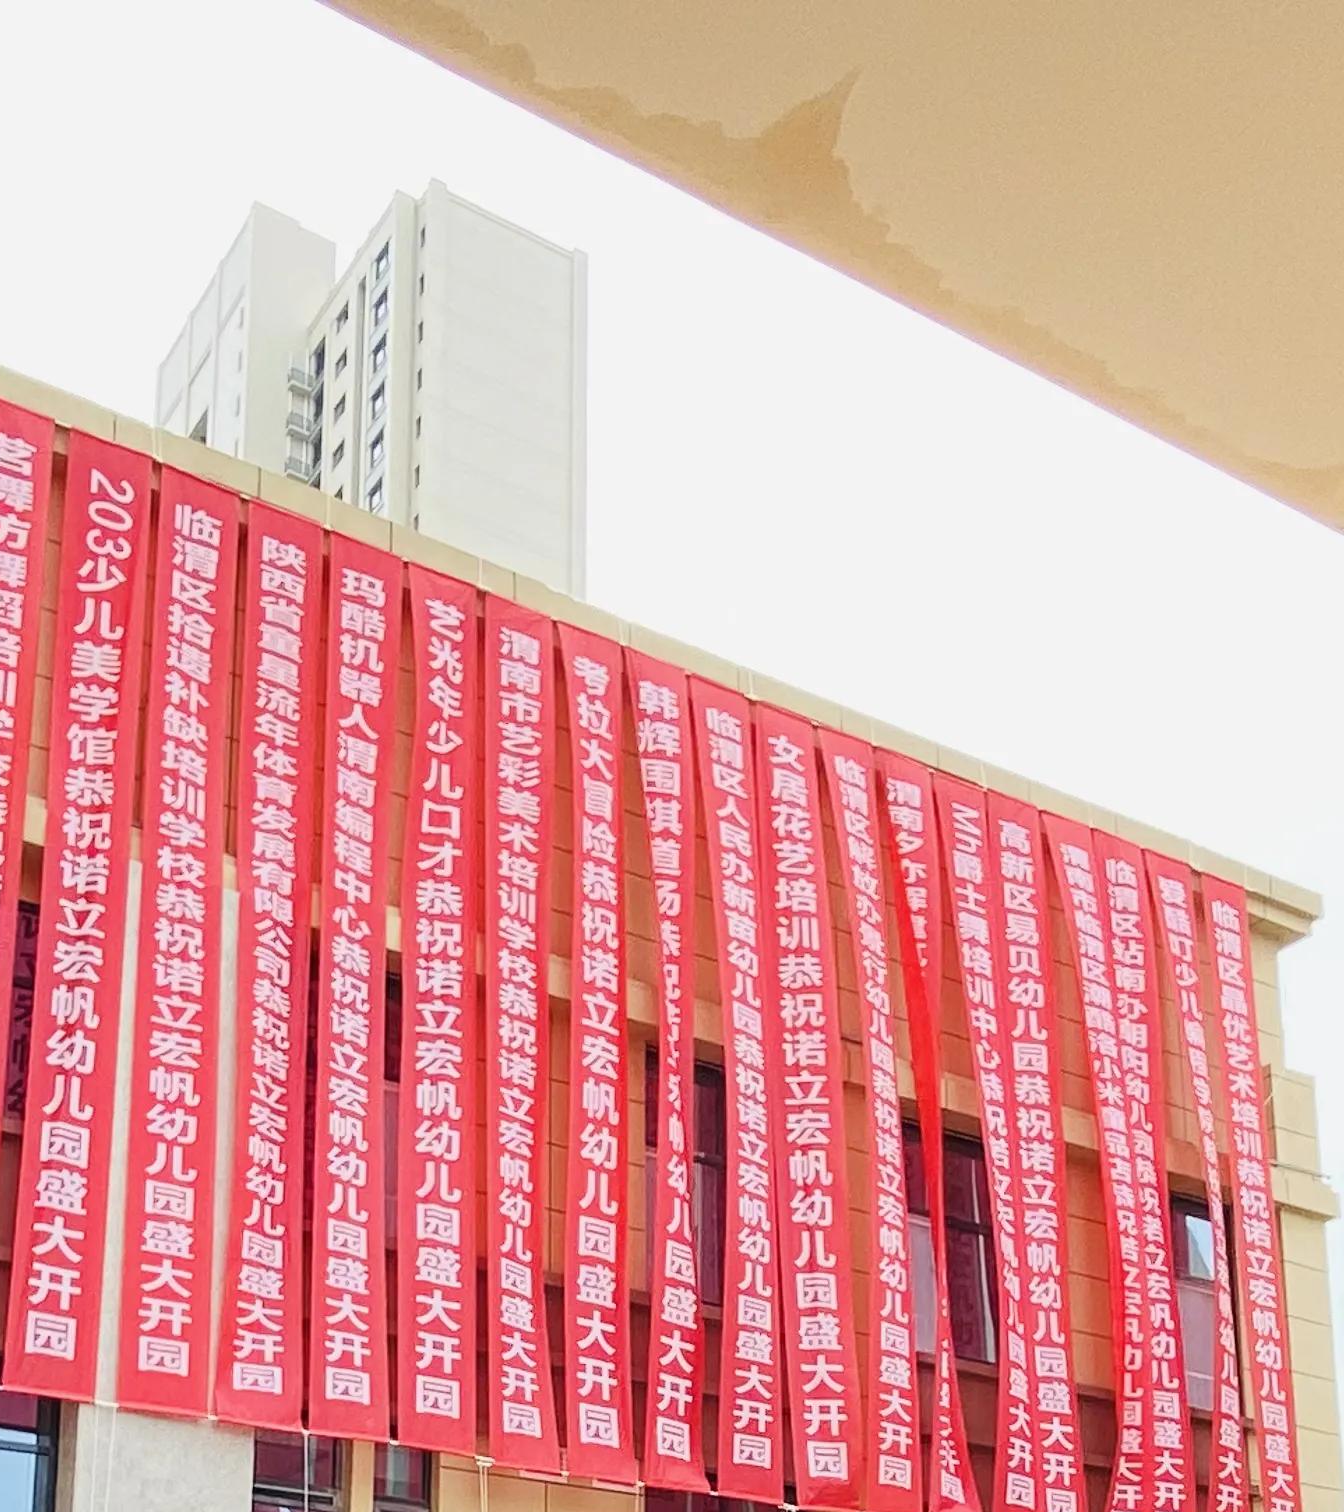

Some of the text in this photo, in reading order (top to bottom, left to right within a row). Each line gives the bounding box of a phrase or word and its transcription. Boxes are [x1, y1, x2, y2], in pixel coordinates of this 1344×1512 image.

[24, 468, 135, 1362] 203少儿美学馆恭祝诺立宏帆幼儿园盛大开园
[572, 654, 621, 1450] 考拉大冒险恭祝诺立宏帆幼儿园盛大开园
